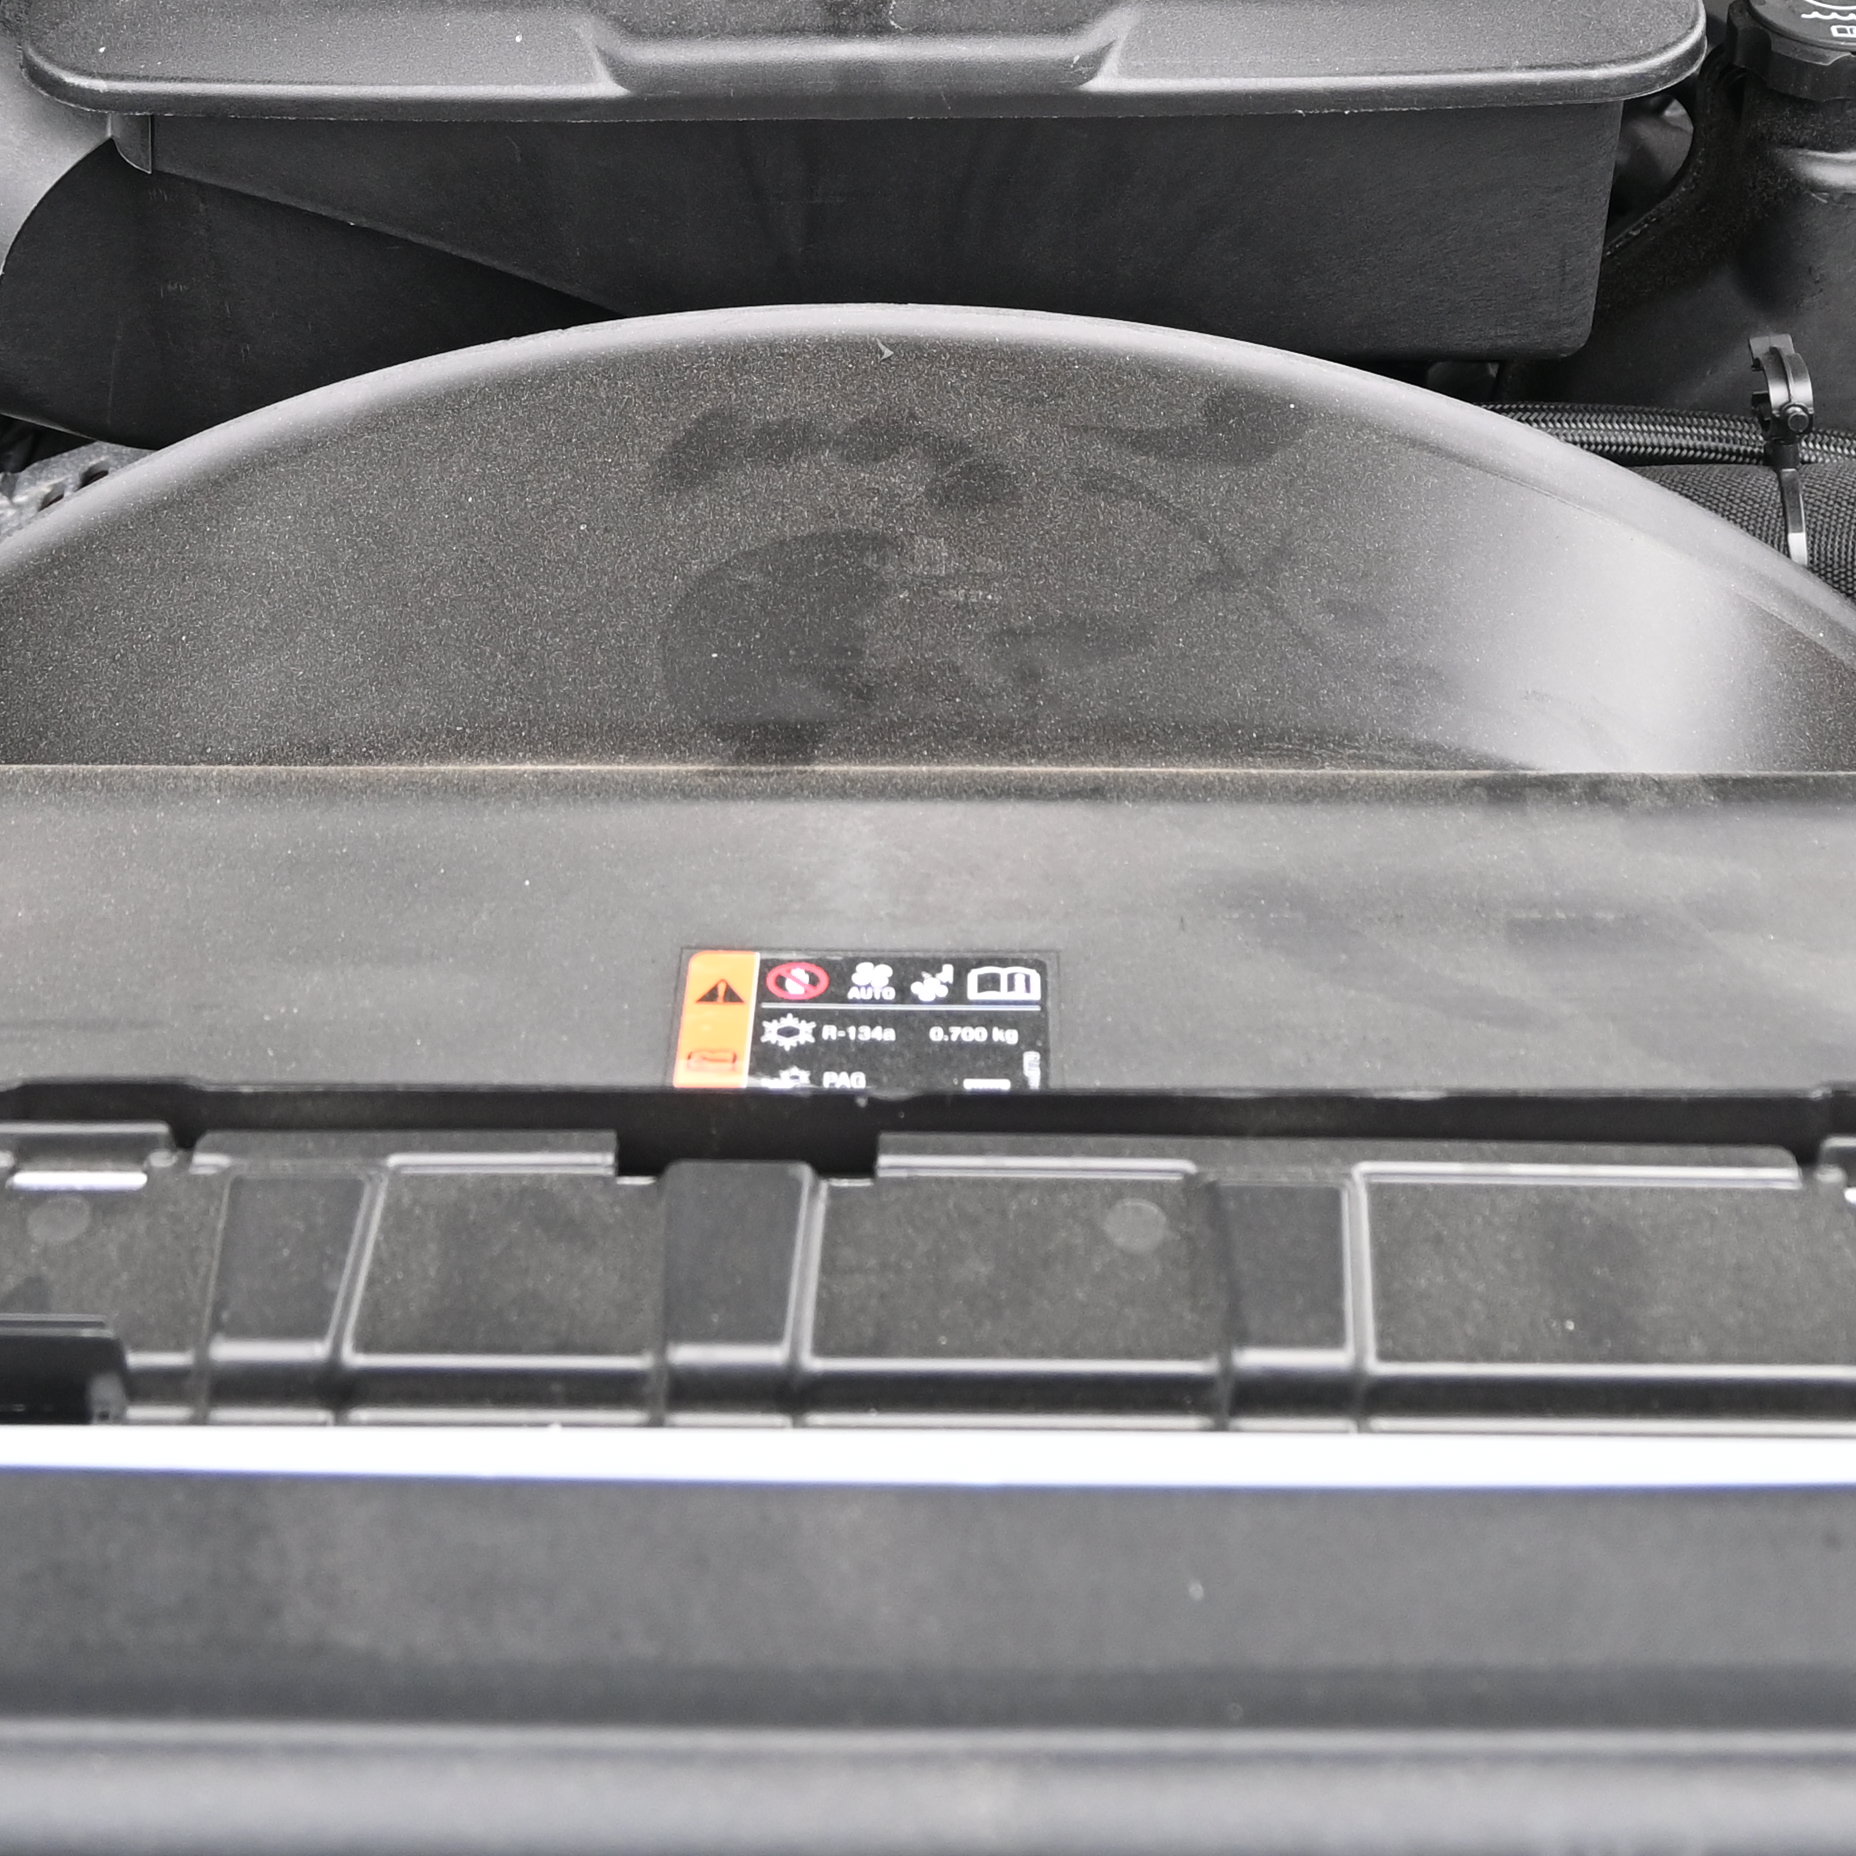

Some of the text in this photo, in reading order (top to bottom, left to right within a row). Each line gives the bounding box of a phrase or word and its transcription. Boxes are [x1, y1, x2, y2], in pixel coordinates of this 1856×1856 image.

[847, 985, 896, 1001] AUTO
[821, 1024, 1019, 1045] R-134a 0.700 kg
[822, 1070, 867, 1089] PAG
